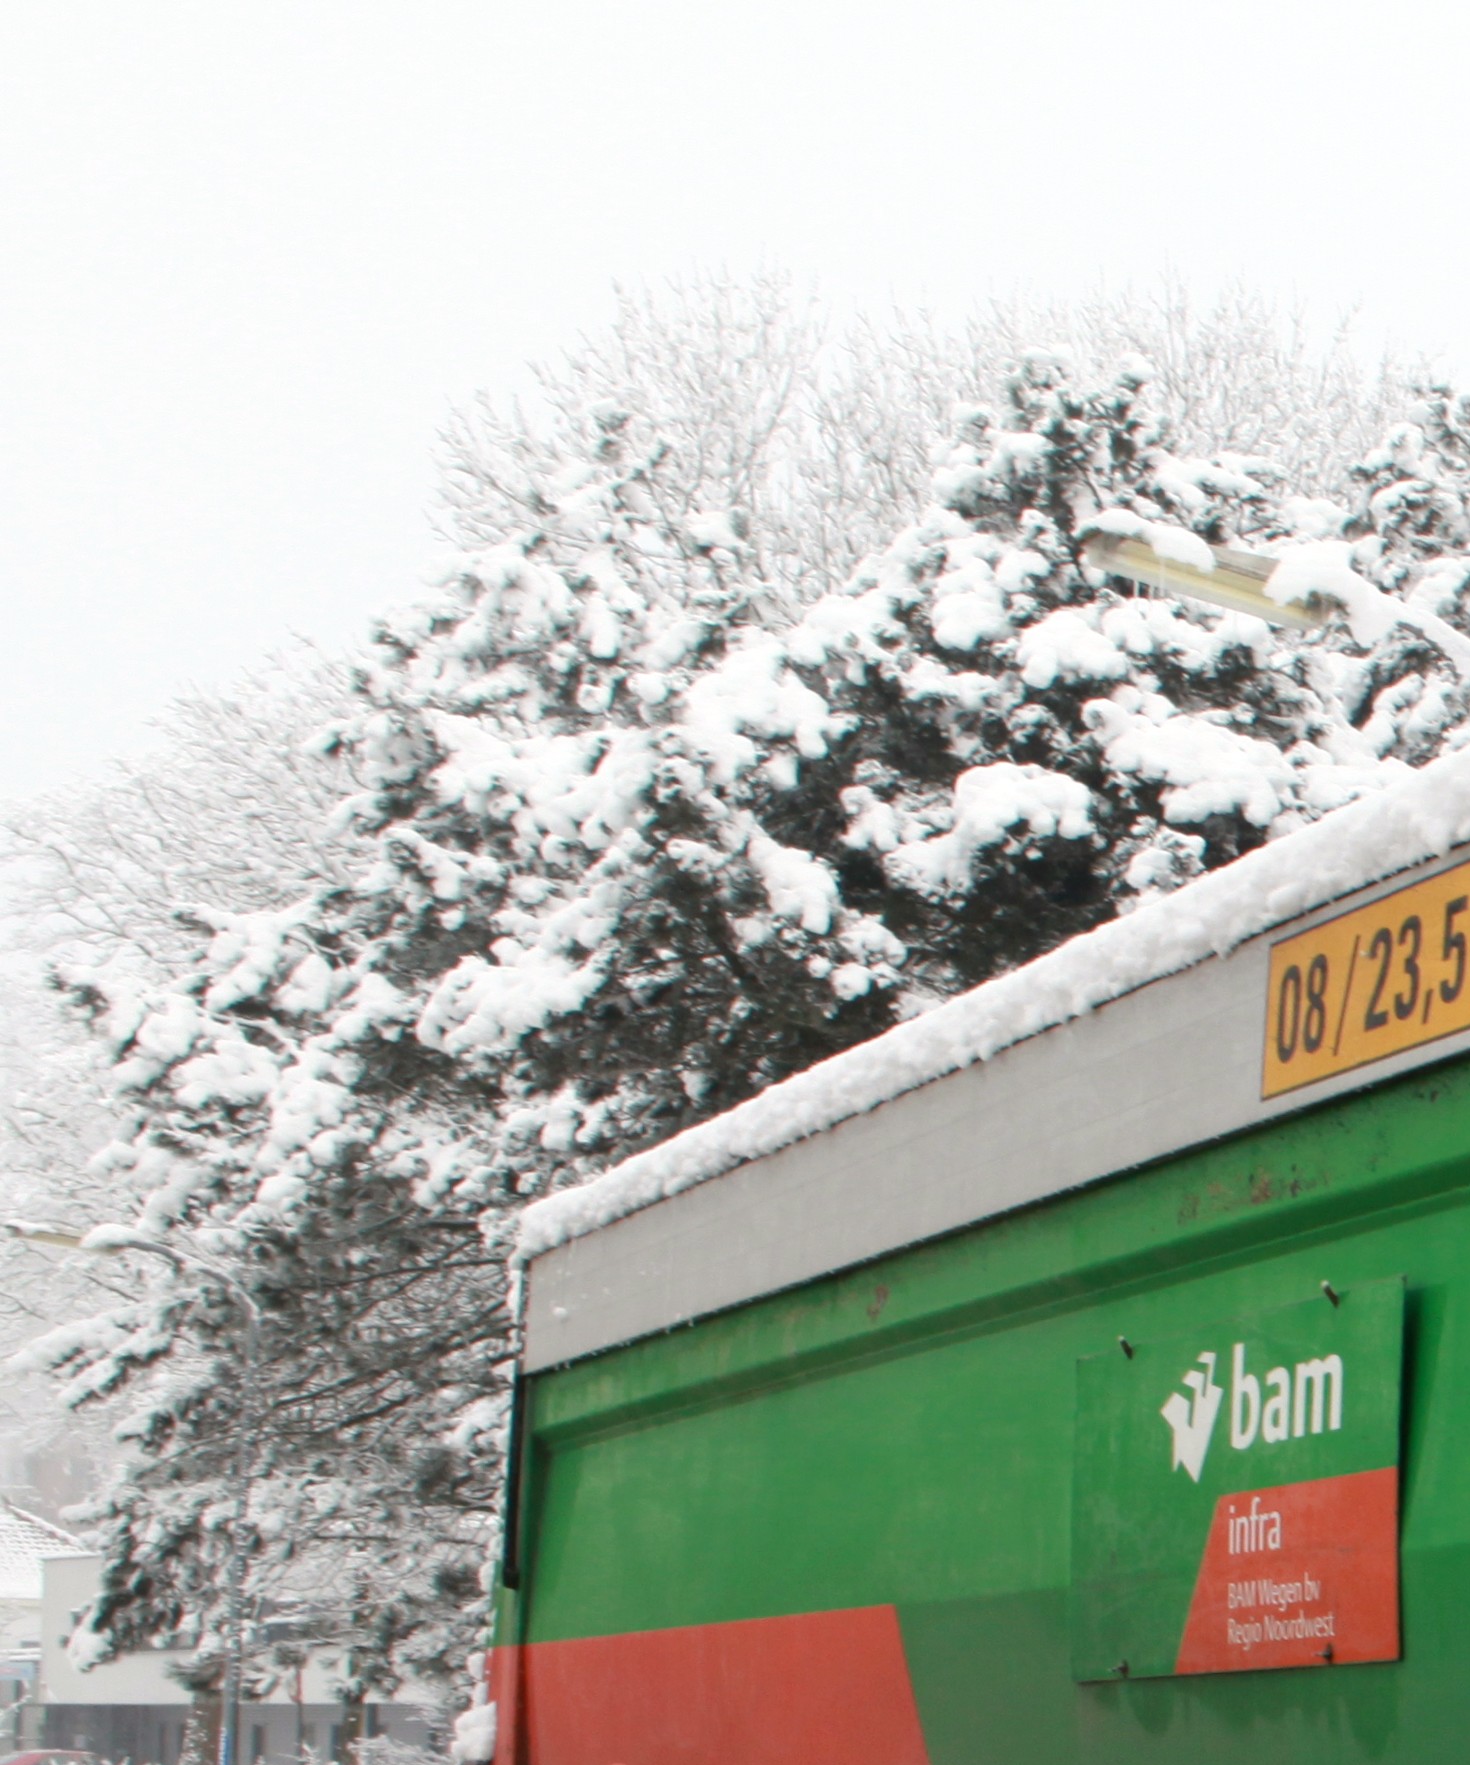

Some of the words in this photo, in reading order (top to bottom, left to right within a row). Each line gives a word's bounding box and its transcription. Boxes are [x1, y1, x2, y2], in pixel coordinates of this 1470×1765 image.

[1275, 895, 1469, 1063] 08/23,5
[1229, 1342, 1343, 1450] bam
[1228, 1496, 1282, 1555] infra
[1228, 1580, 1256, 1609] BAM
[1258, 1579, 1302, 1612] Wegen
[1303, 1571, 1321, 1602] bv
[1228, 1616, 1262, 1651] Regio
[1263, 1609, 1335, 1642] Noordwest
